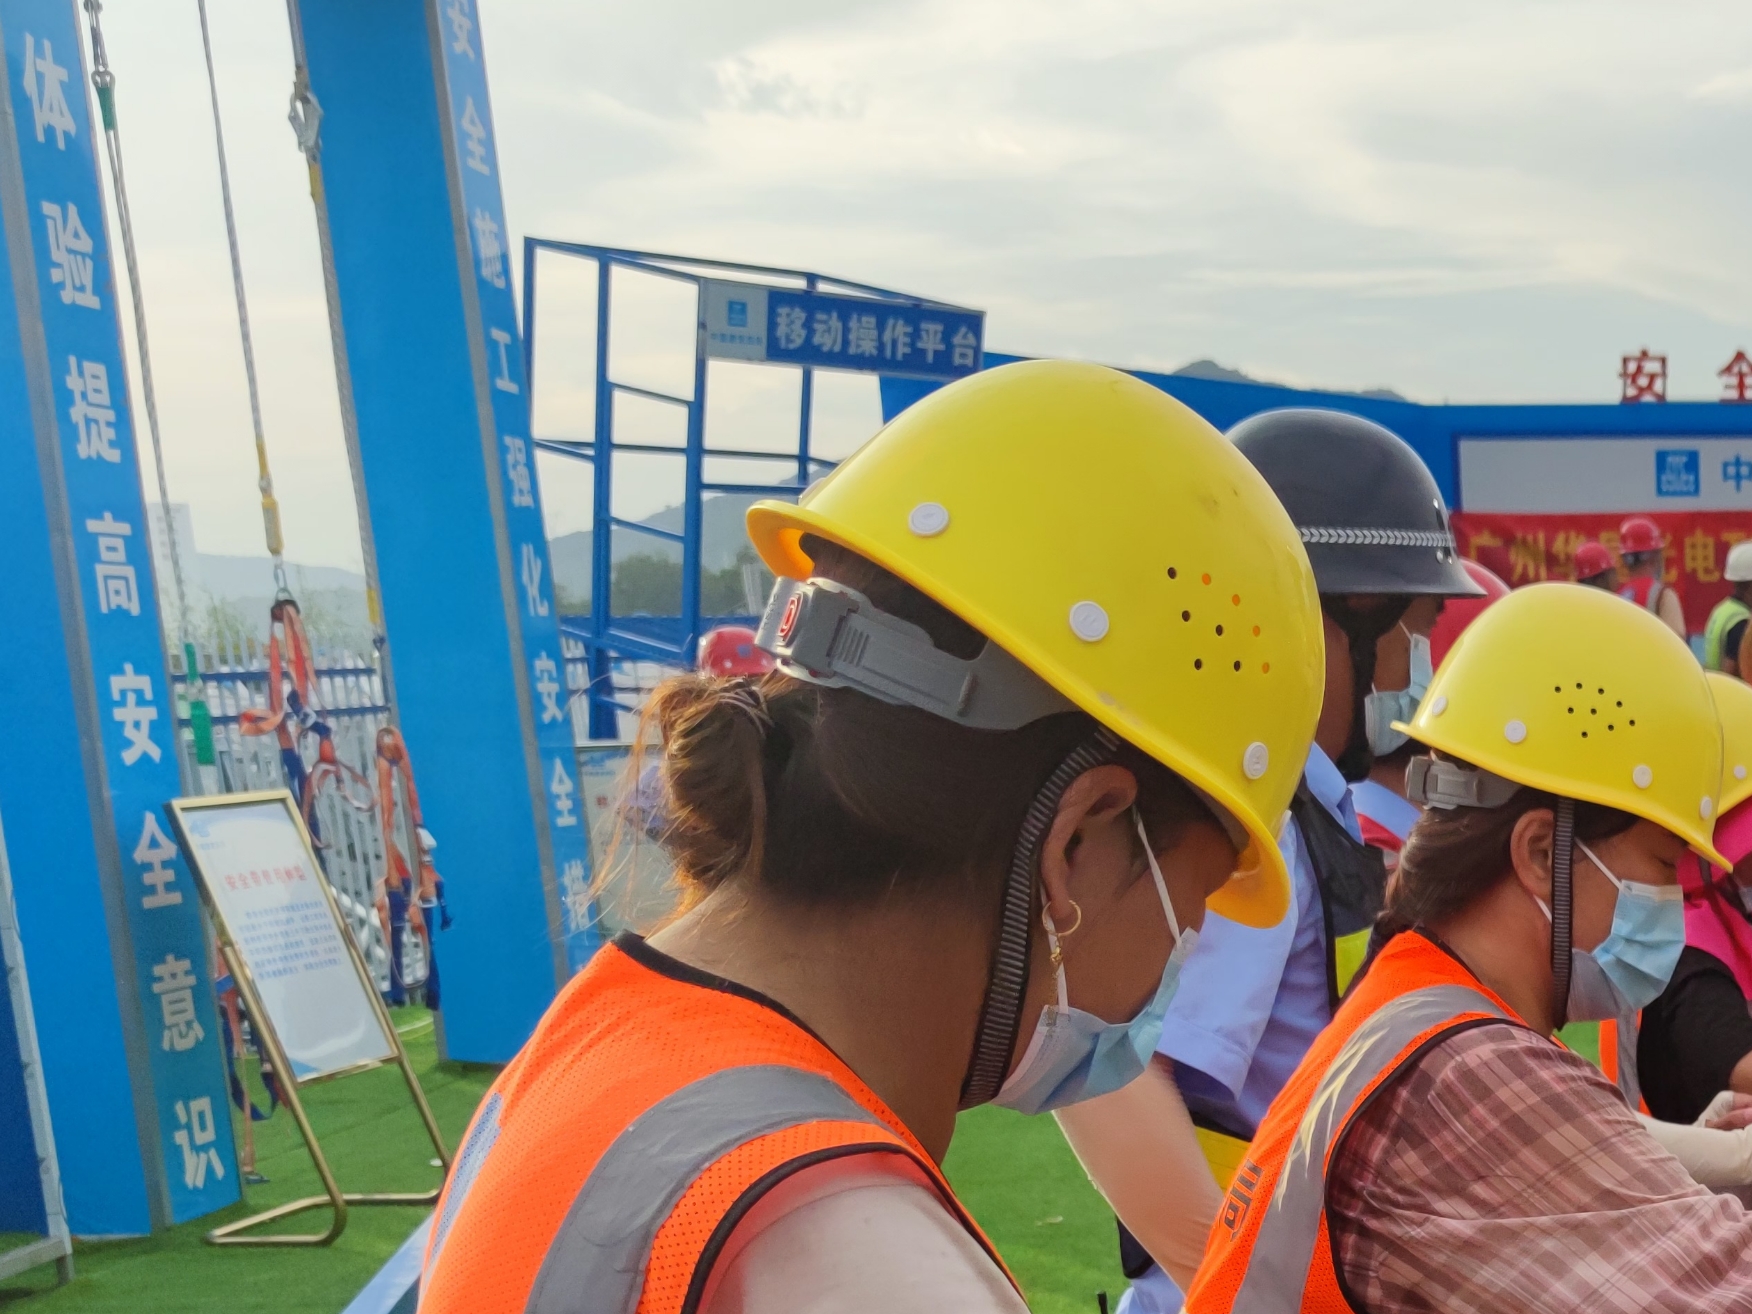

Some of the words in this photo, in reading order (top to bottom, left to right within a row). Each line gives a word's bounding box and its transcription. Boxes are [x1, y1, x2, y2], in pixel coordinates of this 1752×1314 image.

[23, 32, 226, 1191] 体验提高安全意识
[775, 306, 978, 368] 移动操作平台
